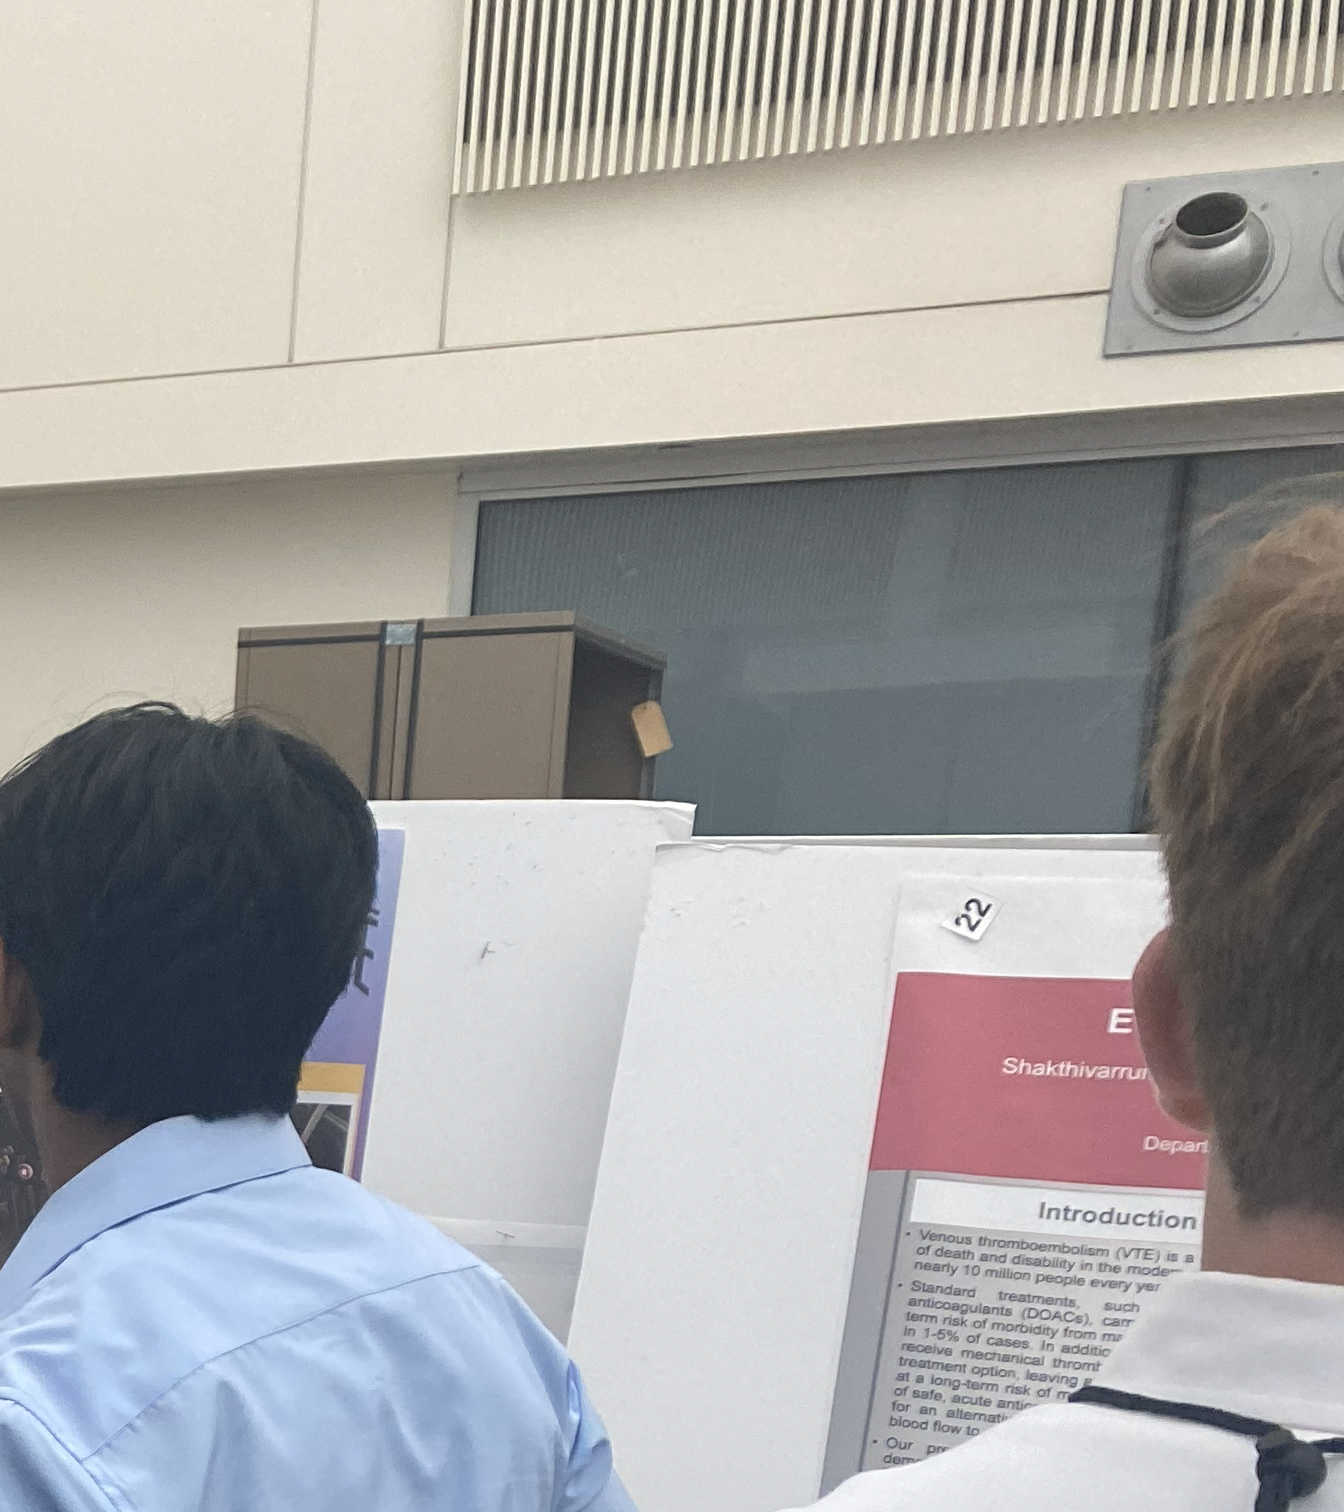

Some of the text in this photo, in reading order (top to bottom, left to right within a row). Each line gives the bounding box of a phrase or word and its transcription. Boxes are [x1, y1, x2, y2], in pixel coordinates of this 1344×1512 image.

[954, 896, 994, 933] 22
[1143, 1136, 1210, 1154] Depart
[1039, 1201, 1197, 1230] Introduction
[919, 1229, 1160, 1262] Venous thromboembolism (VTE)
[934, 1246, 1121, 1274] death and disability the
[915, 1261, 1132, 1293] nearly million people every
[908, 1297, 1012, 1318] anticoagulants
[911, 1281, 976, 1298] Standard
[1104, 1300, 1140, 1313] such
[923, 1328, 960, 1342] 1-5%
[991, 1321, 1059, 1339] morbidity
[930, 1374, 999, 1393] long-term
[889, 1416, 962, 1435] blood flow
